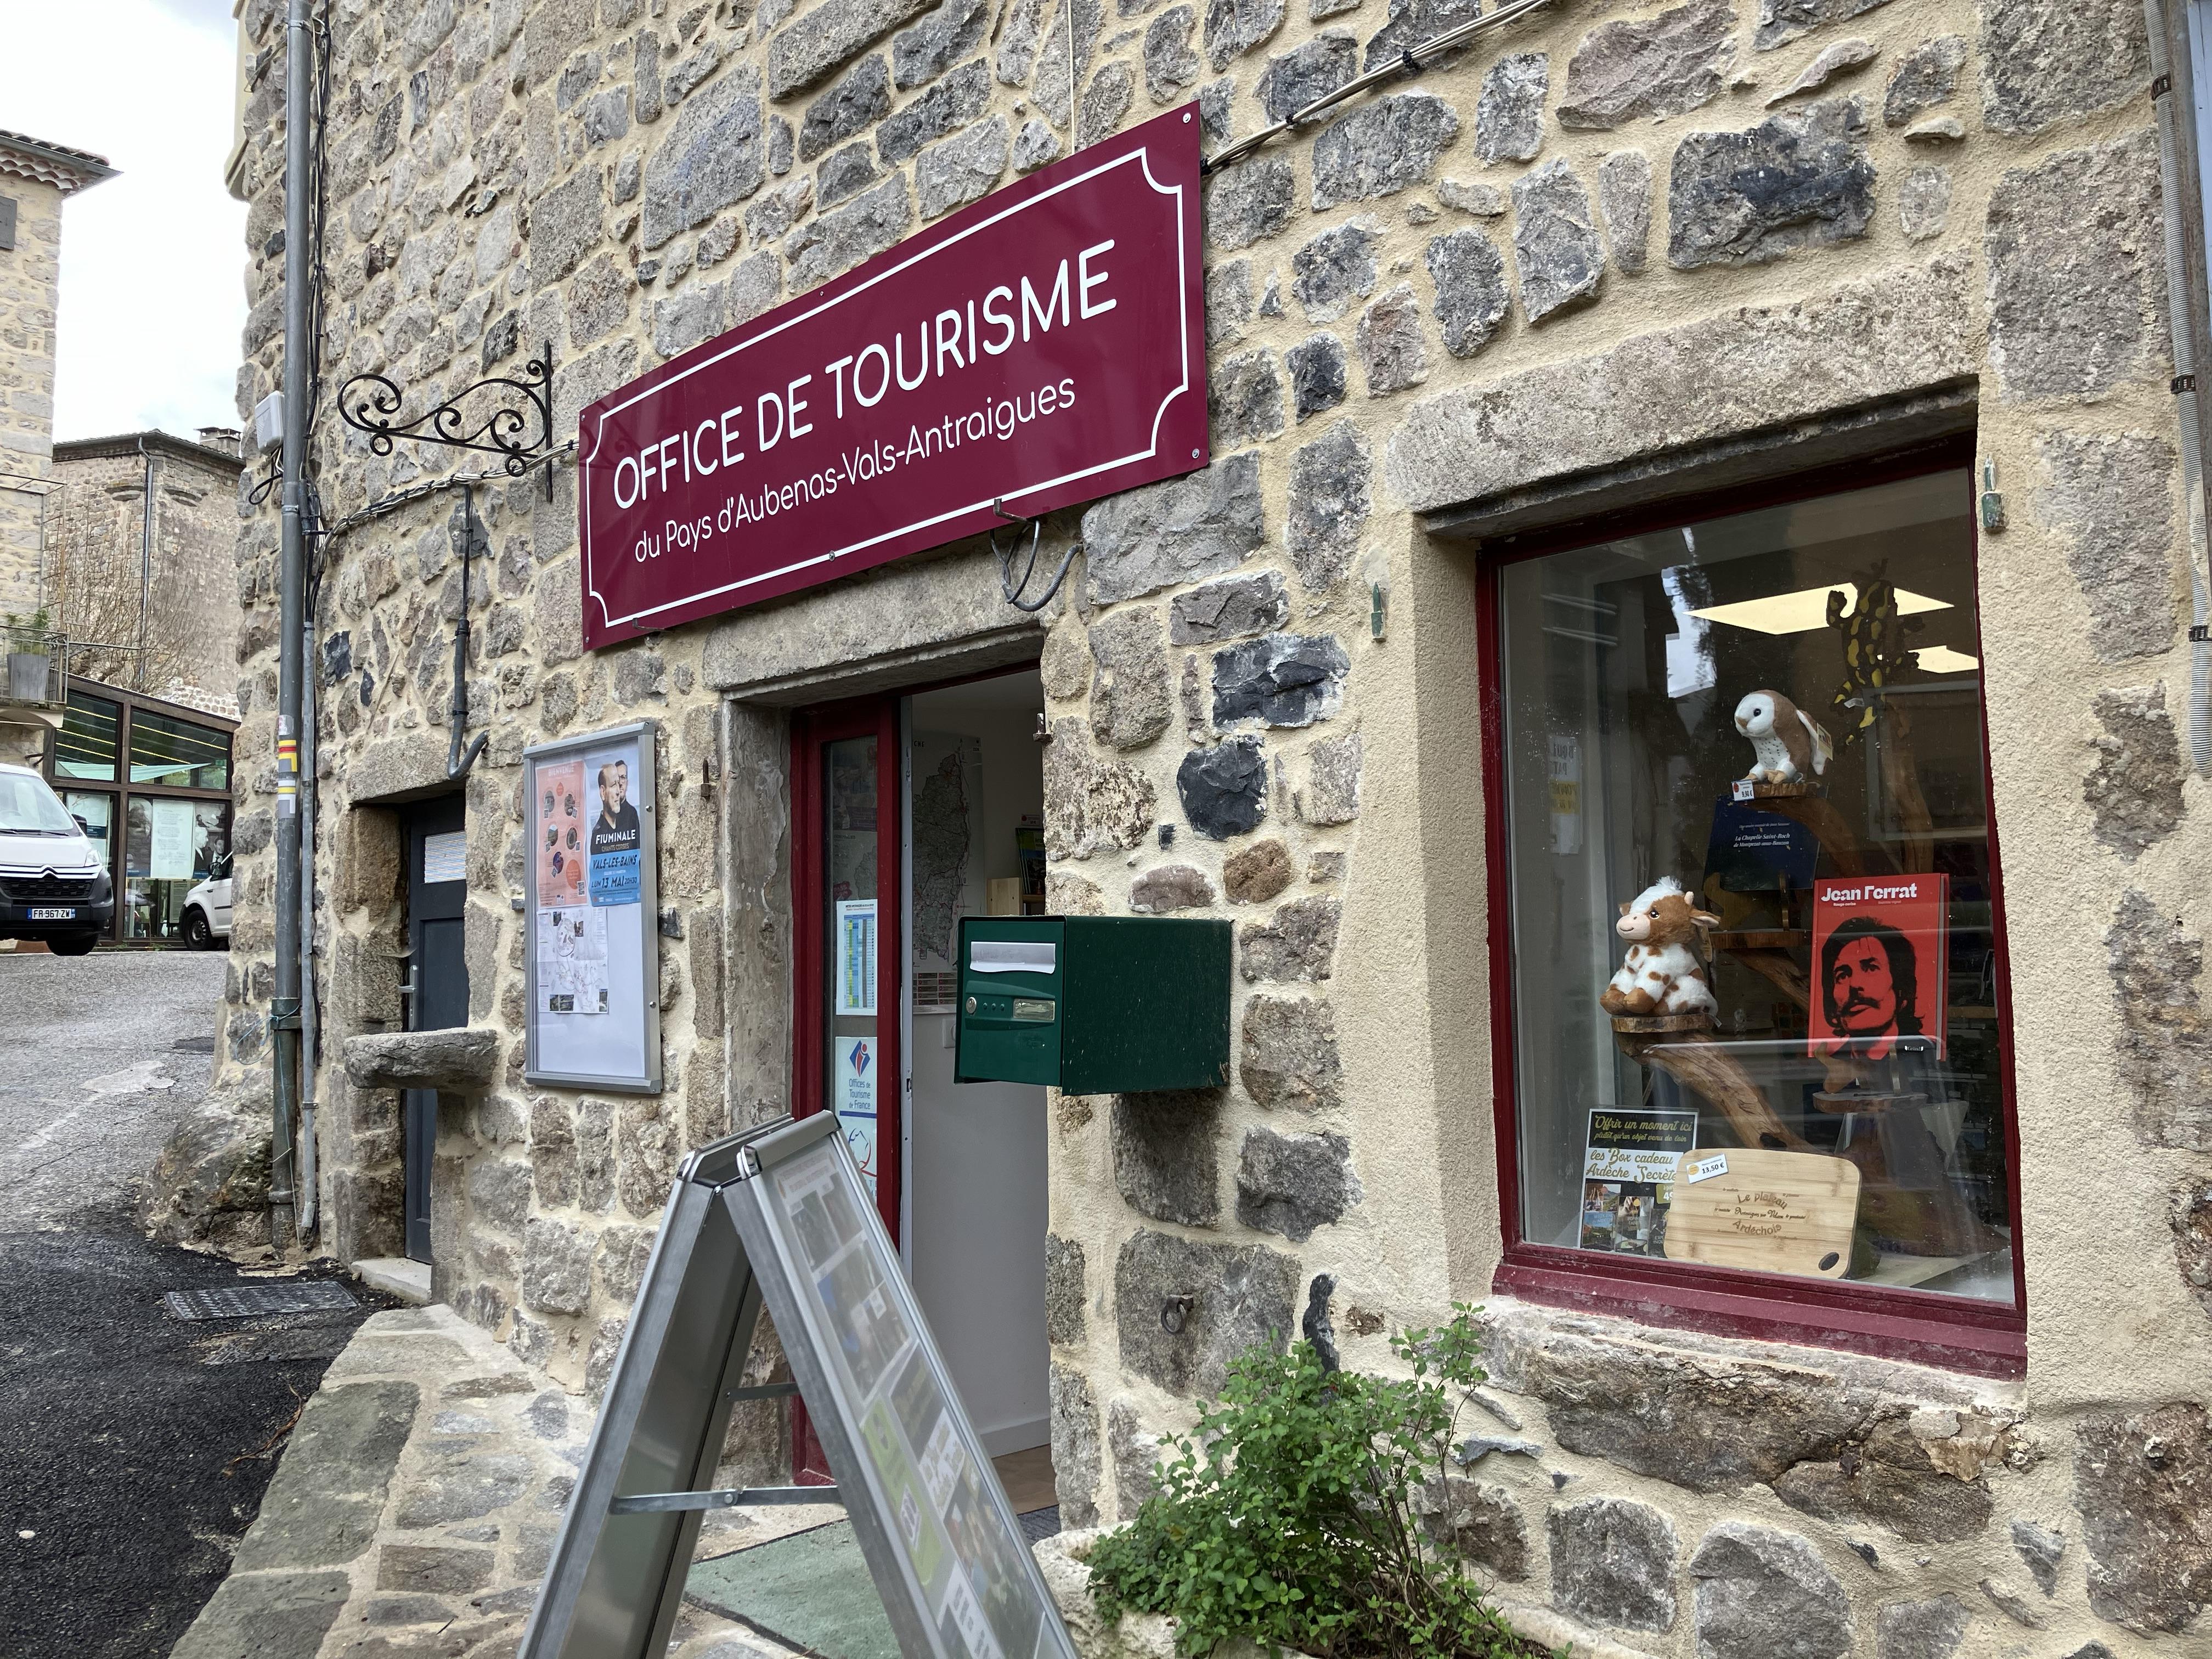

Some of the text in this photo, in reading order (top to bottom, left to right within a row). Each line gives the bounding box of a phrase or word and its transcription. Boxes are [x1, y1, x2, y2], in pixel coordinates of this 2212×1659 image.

[613, 239, 1117, 510] OFFICE DE TOURISME
[634, 377, 1076, 563] du Pays d'Aubenas-Vals-Antraigues
[595, 829, 636, 845] FIUMINALE
[593, 854, 637, 870] VALS-LES-BAINS
[602, 877, 608, 889] 13
[611, 875, 624, 888] MAI
[1821, 882, 1917, 901] Jean Ferrat
[849, 1078, 865, 1088] Offices
[849, 1088, 871, 1099] Tourisme
[854, 1099, 871, 1110] France
[1595, 1115, 1693, 1131] Offrir un moment ici
[1632, 1132, 1647, 1143] objet
[1590, 1147, 1673, 1165] les Box cadeau
[1585, 1163, 1630, 1178] Ardèche
[1702, 1164, 1719, 1174] 13,50
[1737, 1191, 1788, 1210] Le plateau
